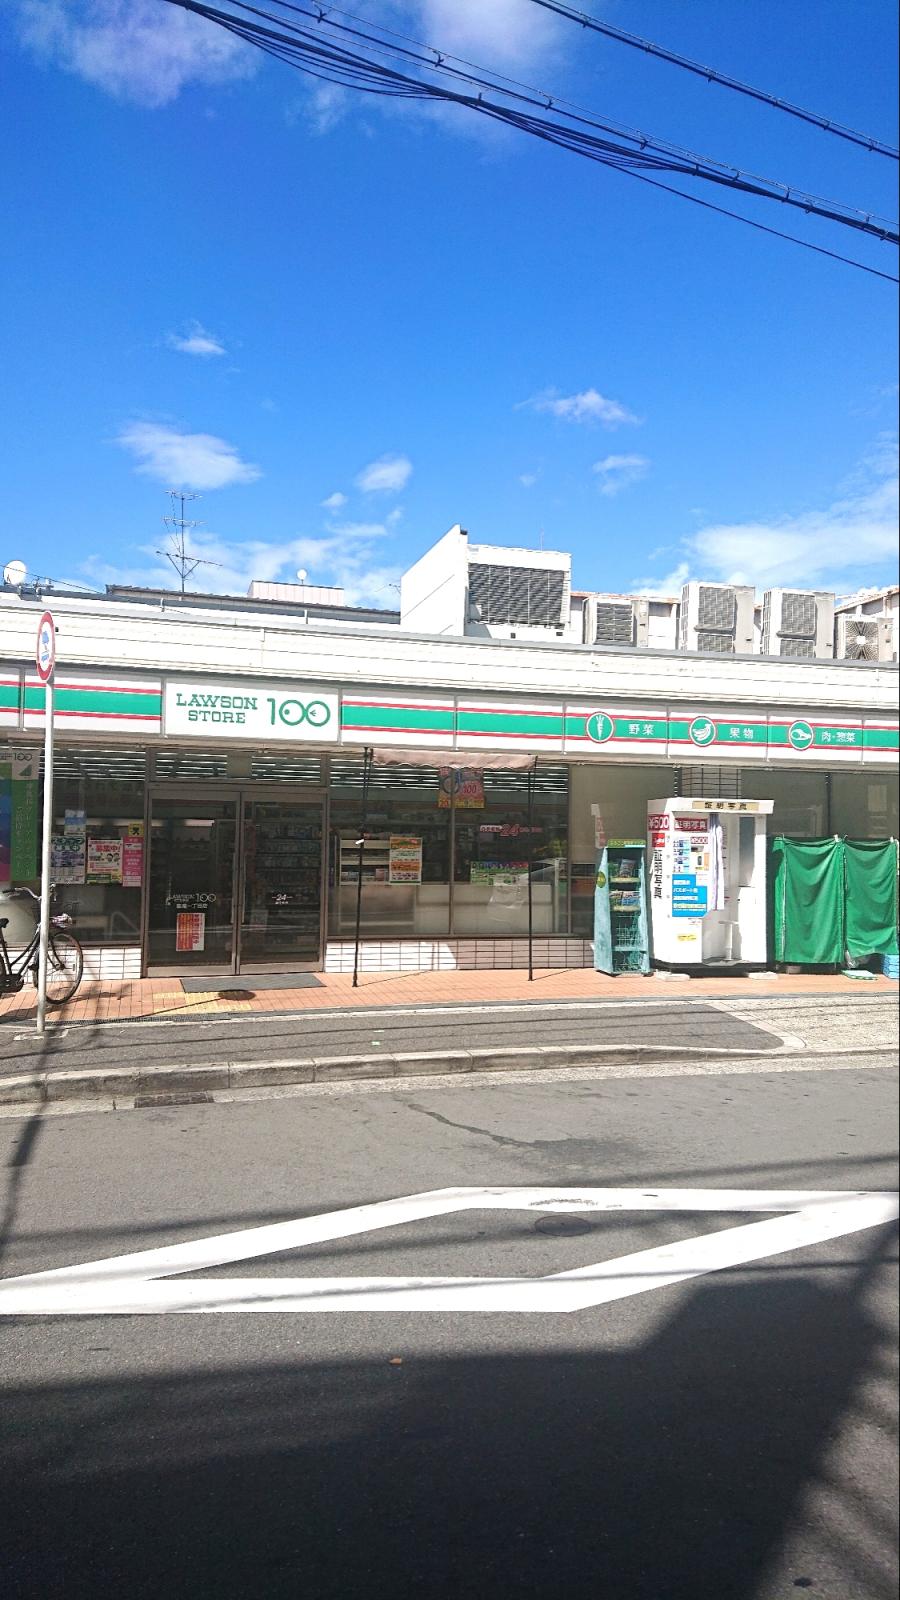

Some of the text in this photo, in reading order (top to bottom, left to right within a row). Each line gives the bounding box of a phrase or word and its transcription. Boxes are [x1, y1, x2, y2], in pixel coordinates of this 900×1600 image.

[176, 693, 331, 727] LAWSON 100
[188, 710, 246, 724] STORE
[628, 723, 655, 735] 野菜
[729, 727, 754, 739] 果物
[704, 801, 748, 810] 証明写真
[649, 815, 670, 829] ¥500
[675, 820, 707, 830] 証明写真
[653, 849, 663, 899] 証明写真
